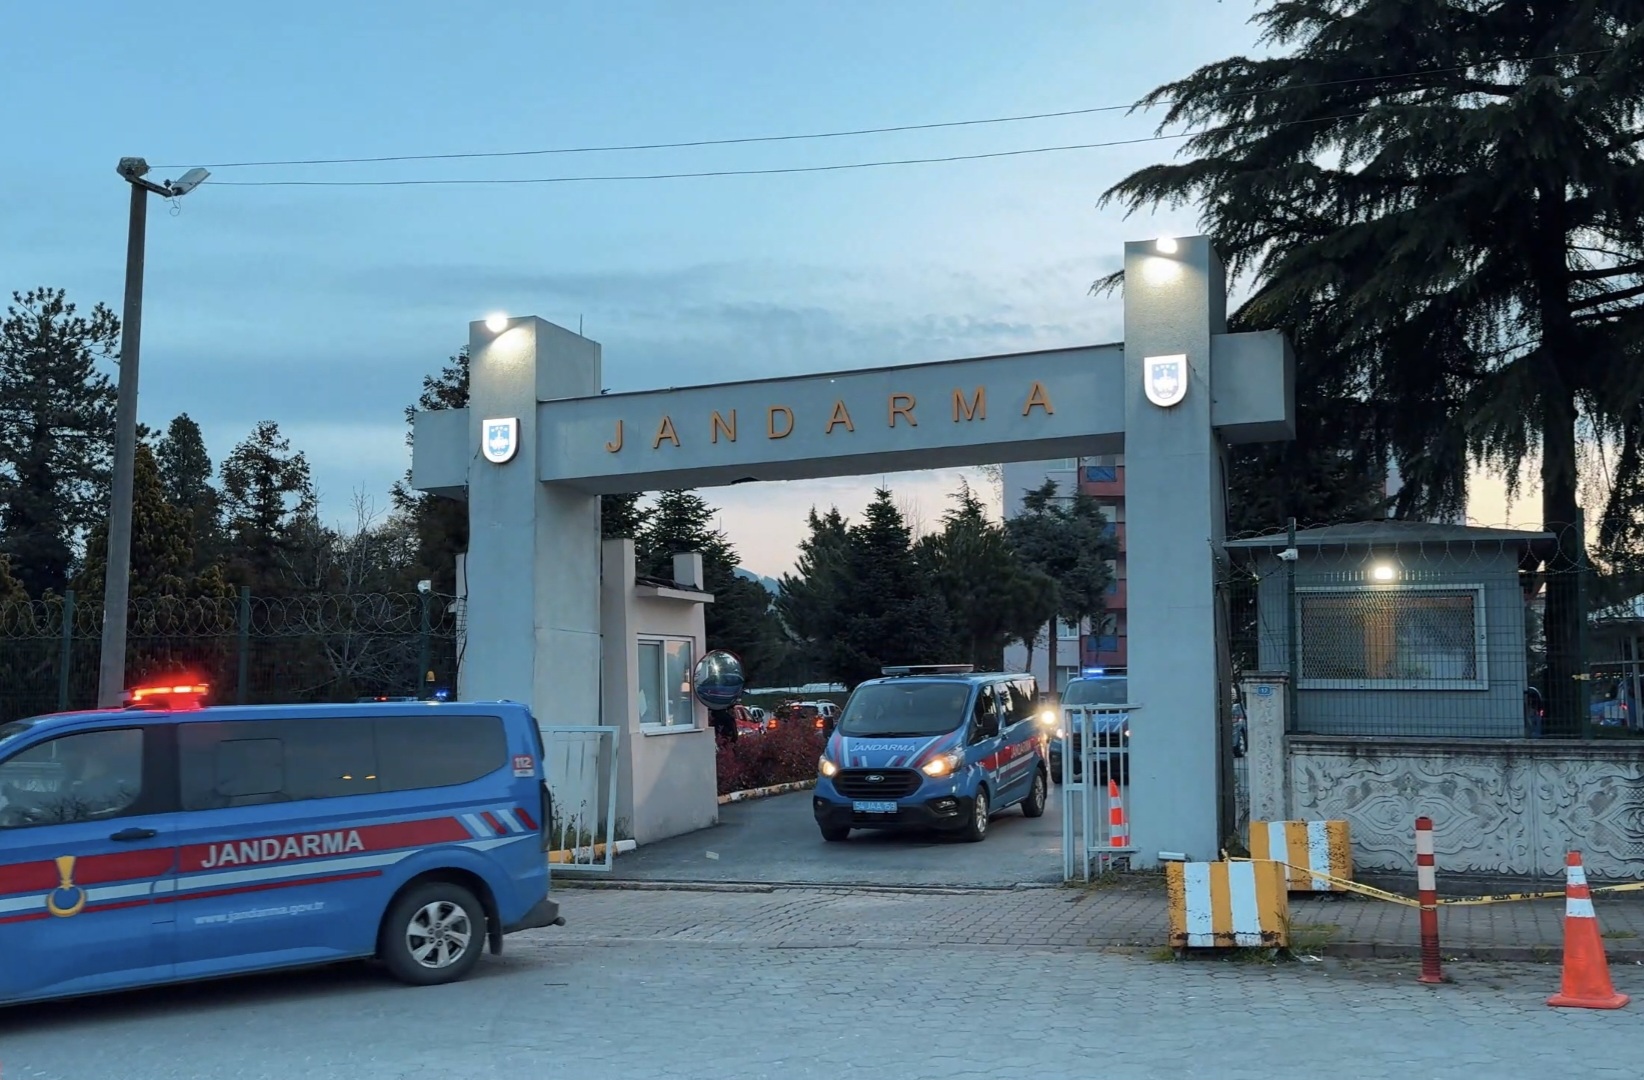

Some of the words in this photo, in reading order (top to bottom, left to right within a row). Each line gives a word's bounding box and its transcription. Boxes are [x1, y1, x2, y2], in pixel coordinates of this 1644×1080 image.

[605, 382, 1054, 454] JANDARMA
[850, 744, 916, 752] JANDARMA
[514, 757, 533, 769] 112
[201, 830, 366, 868] JANDARMA
[194, 902, 325, 924] www.jandarma.gov.tr
